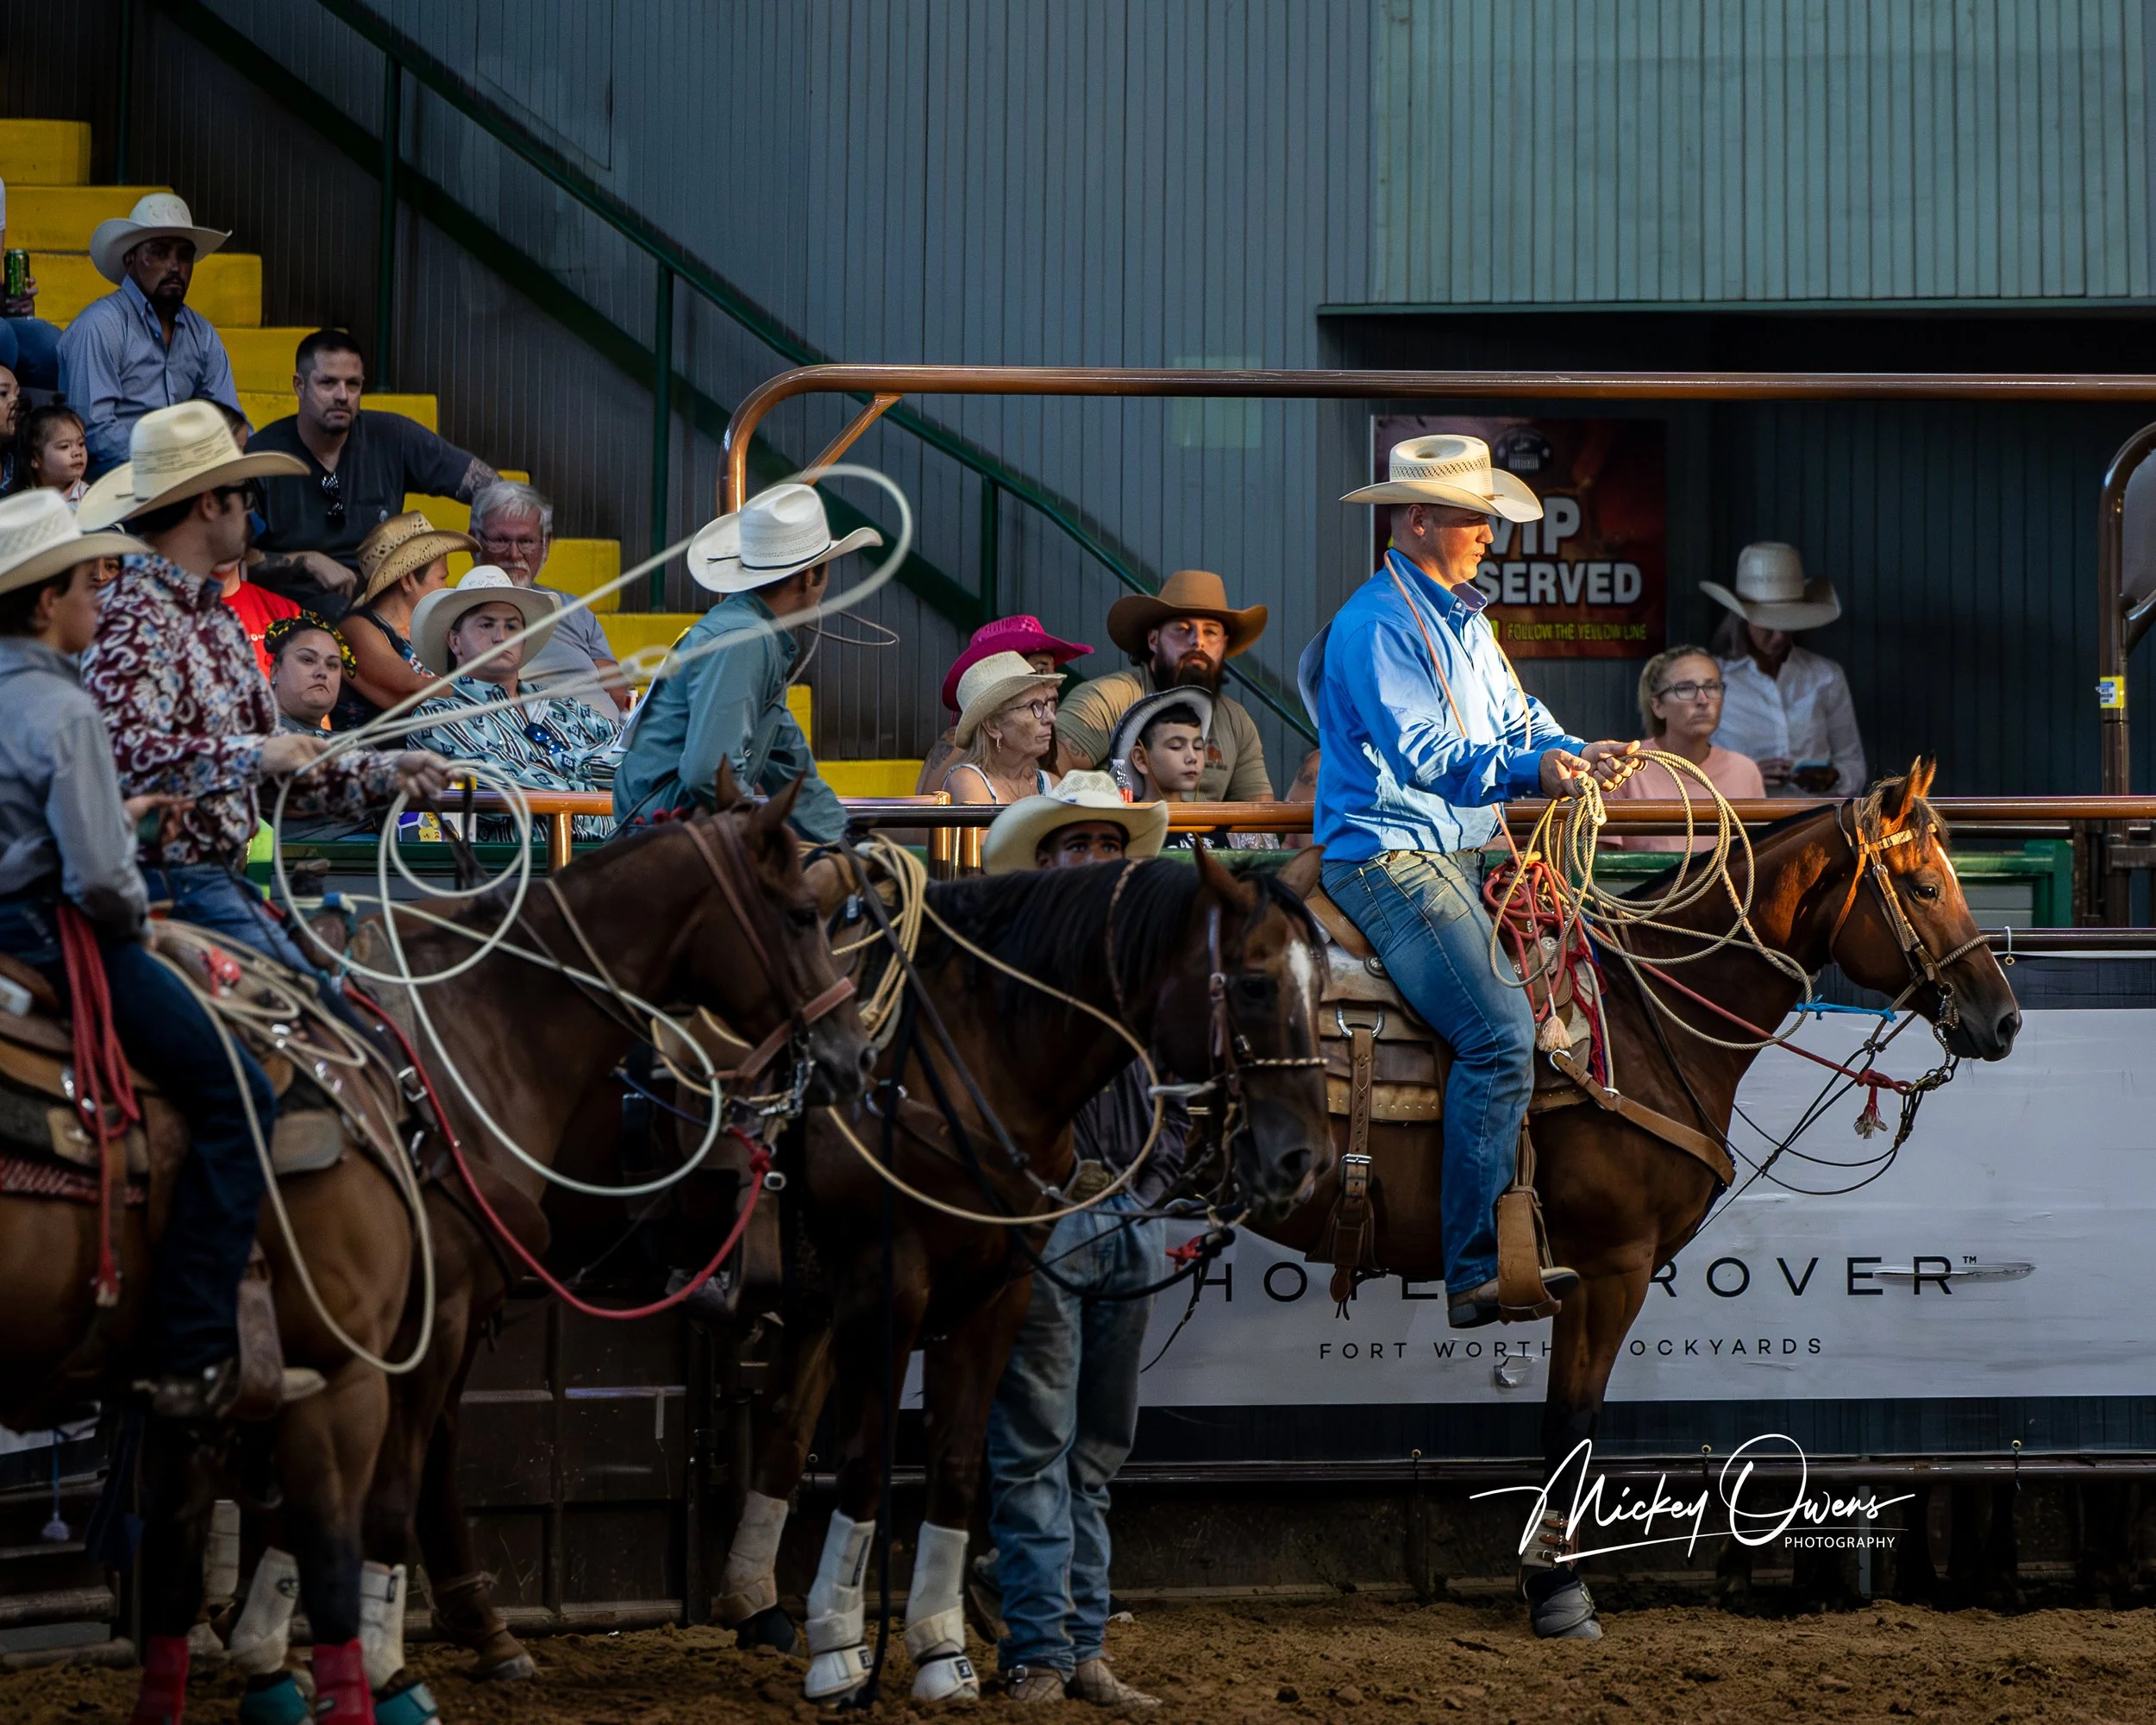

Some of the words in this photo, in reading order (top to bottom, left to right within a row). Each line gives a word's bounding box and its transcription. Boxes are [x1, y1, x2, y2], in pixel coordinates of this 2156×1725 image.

[1487, 496, 1581, 555] VIP
[1475, 561, 1642, 604] SERVED
[1507, 623, 1552, 641] FOLLOW
[1555, 623, 1575, 641] THE
[1577, 623, 1621, 641] YELLOW
[1623, 623, 1647, 641] LINE
[1649, 1256, 1953, 1298] ROVER
[1319, 1342, 1407, 1359] FORT
[1432, 1340, 1552, 1359] WORTH
[1629, 1338, 1821, 1356] OCKYARDS
